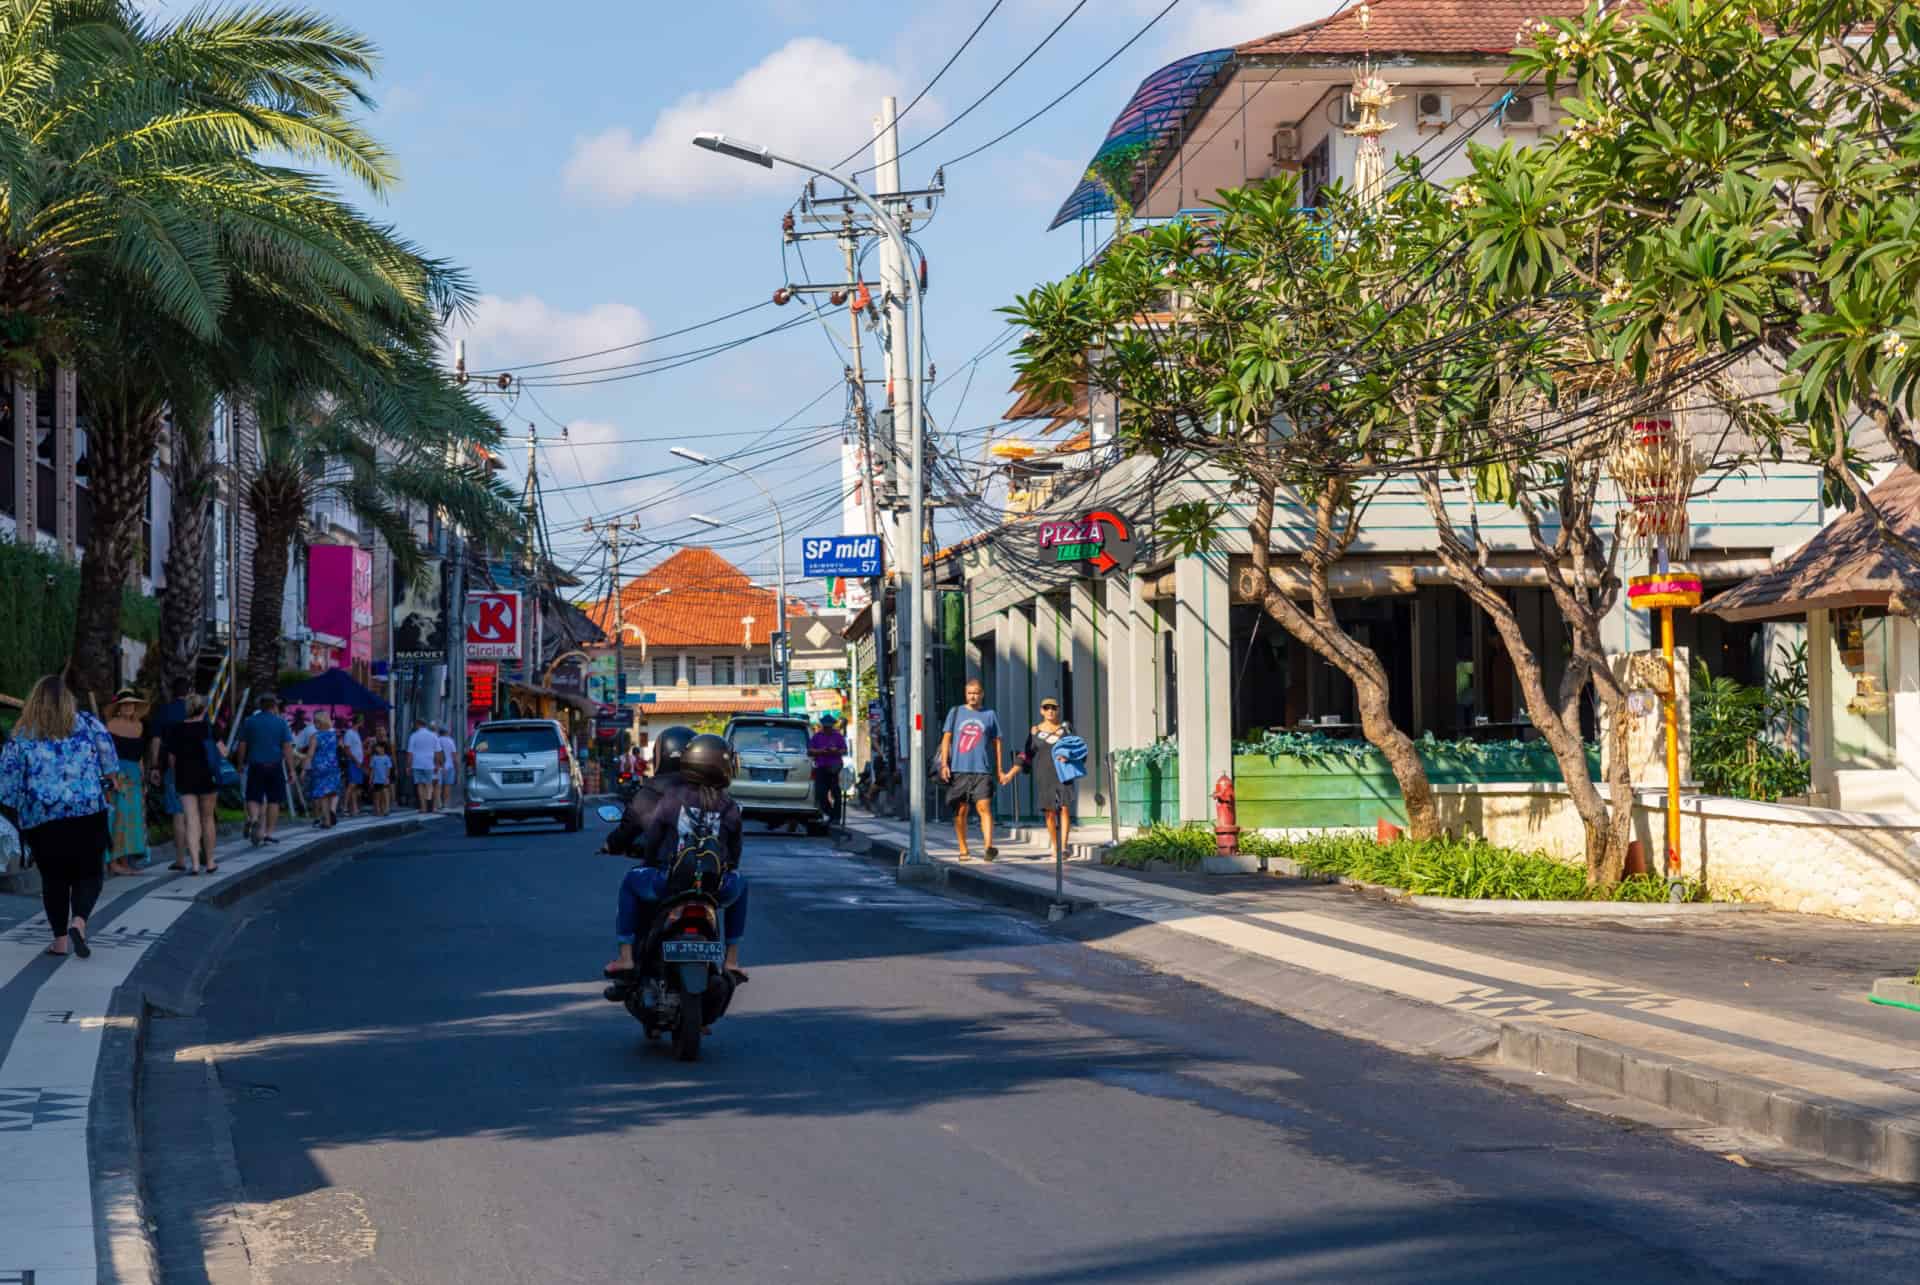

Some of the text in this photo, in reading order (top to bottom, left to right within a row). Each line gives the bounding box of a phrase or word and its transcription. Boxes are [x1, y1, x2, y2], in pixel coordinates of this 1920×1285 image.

[1041, 522, 1100, 544] PIZZA
[805, 539, 877, 559] SP midi
[862, 561, 877, 572] 57
[467, 645, 516, 656] Circle K
